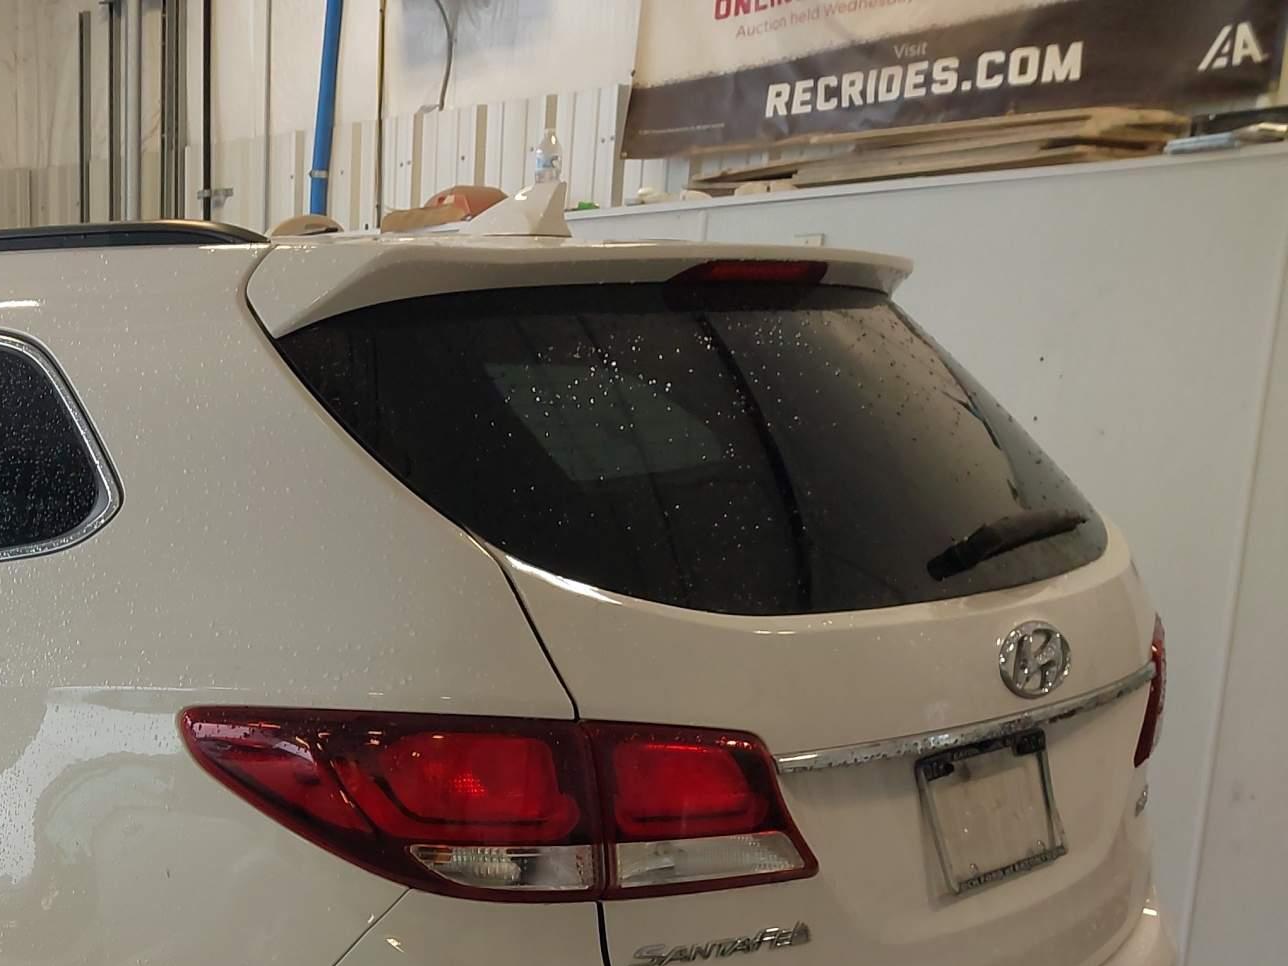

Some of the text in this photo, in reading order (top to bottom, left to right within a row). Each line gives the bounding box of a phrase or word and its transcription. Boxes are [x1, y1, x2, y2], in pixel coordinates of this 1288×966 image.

[736, 0, 912, 38] Auction held Wednes
[894, 42, 928, 59] Visit
[765, 41, 1083, 118] RECRIDES.COM
